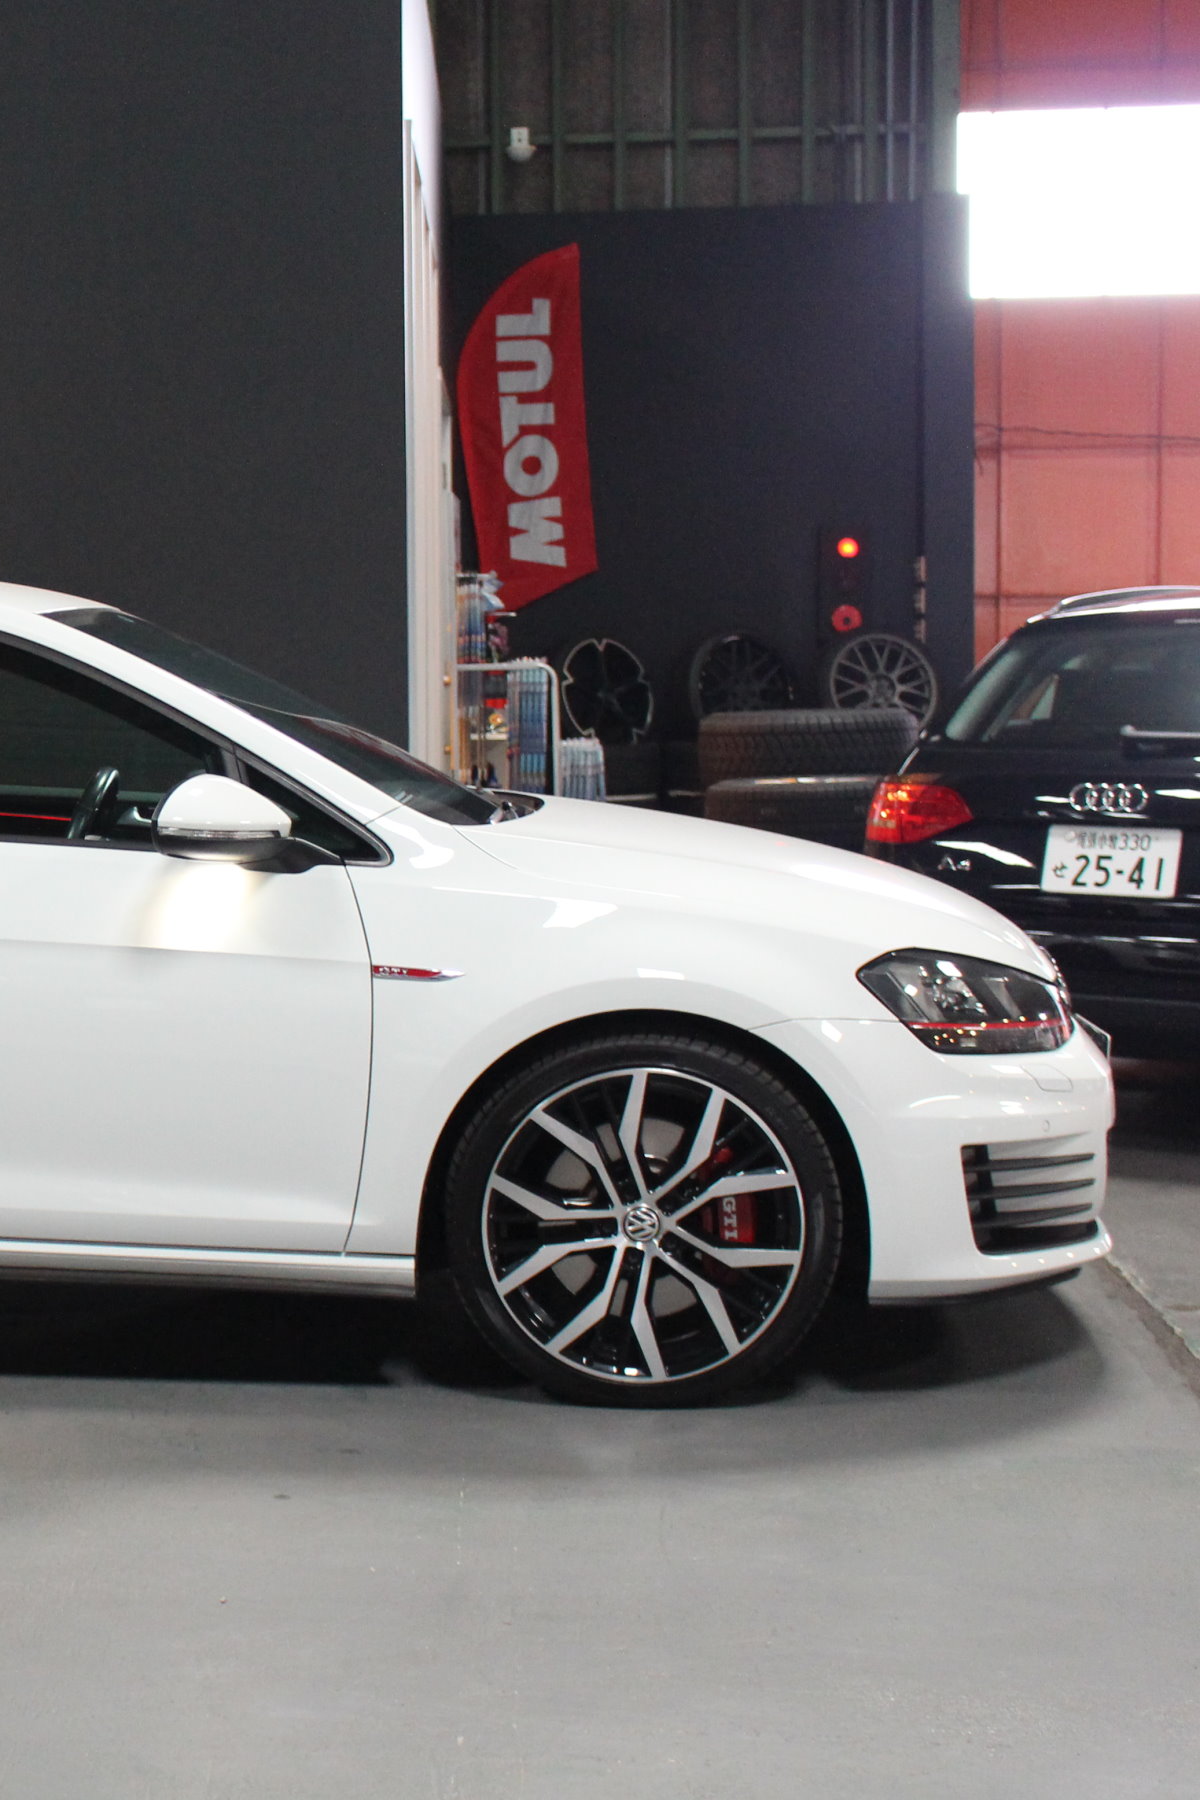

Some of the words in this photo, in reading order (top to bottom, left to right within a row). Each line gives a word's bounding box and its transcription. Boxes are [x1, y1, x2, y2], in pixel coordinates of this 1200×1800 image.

[495, 297, 567, 567] MOTUL
[1071, 854, 1164, 890] 25-41
[722, 1196, 738, 1240] GTI
